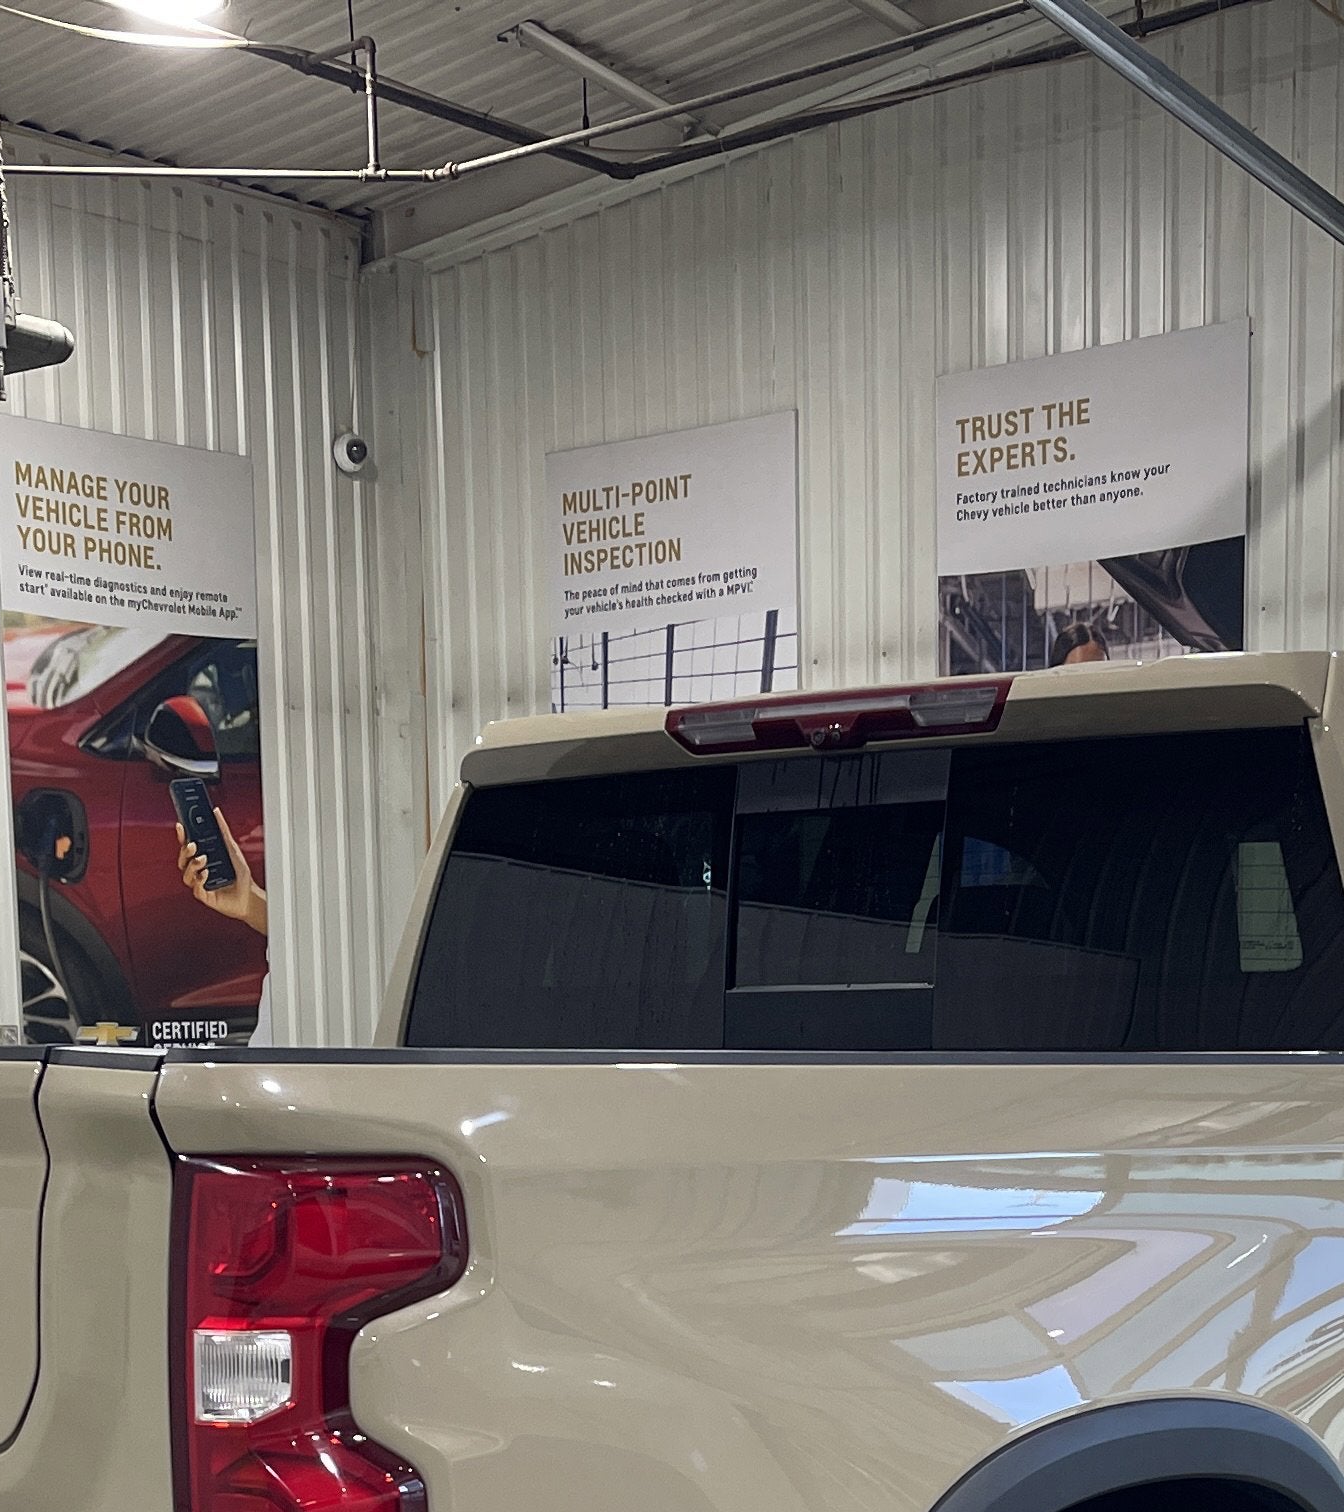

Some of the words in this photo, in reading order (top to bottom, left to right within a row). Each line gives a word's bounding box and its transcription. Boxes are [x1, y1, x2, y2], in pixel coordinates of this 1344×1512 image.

[956, 407, 1034, 444] TRUST
[1041, 397, 1090, 430] THE
[957, 436, 1076, 478] EXPERTS.
[14, 460, 108, 501] MANAGE
[113, 479, 171, 511] YOUR
[562, 473, 692, 516] MULTI-POINT
[956, 490, 997, 505] Factory
[1001, 482, 1040, 499] trained
[1043, 474, 1107, 494] technicians
[1110, 469, 1141, 484] know
[1143, 463, 1171, 481] your
[956, 508, 989, 521] Chevy
[991, 501, 1030, 517] vehicle
[1033, 498, 1067, 512] better
[1070, 493, 1096, 507] than
[1099, 486, 1144, 504] anyone.
[15, 492, 109, 532] VEHICLE
[115, 510, 173, 542] FROM
[562, 512, 645, 546] VEHICLE
[16, 524, 77, 559] YOUR
[84, 536, 162, 571] PHONE.
[563, 537, 682, 576] INSPECTION
[18, 564, 42, 579] View
[45, 570, 91, 587] real-time
[93, 576, 148, 595] diagnostics
[150, 585, 167, 596] and
[169, 587, 194, 602] enjoy
[196, 591, 228, 603] remote
[50, 587, 93, 603] available
[95, 594, 107, 605] on
[110, 594, 125, 607] the
[127, 598, 186, 615] myChevrolet
[188, 603, 217, 617] Mobile
[564, 590, 580, 601] The
[582, 588, 607, 602] peace
[609, 583, 619, 595] of
[621, 581, 643, 594] mind
[645, 579, 664, 591] that
[666, 576, 696, 588] comes
[698, 572, 721, 584] from
[723, 566, 757, 583] getting
[564, 606, 584, 619] your
[625, 596, 654, 609] health
[656, 590, 693, 605] checked
[695, 587, 716, 600] with
[151, 1020, 228, 1040] CERTIFIED
